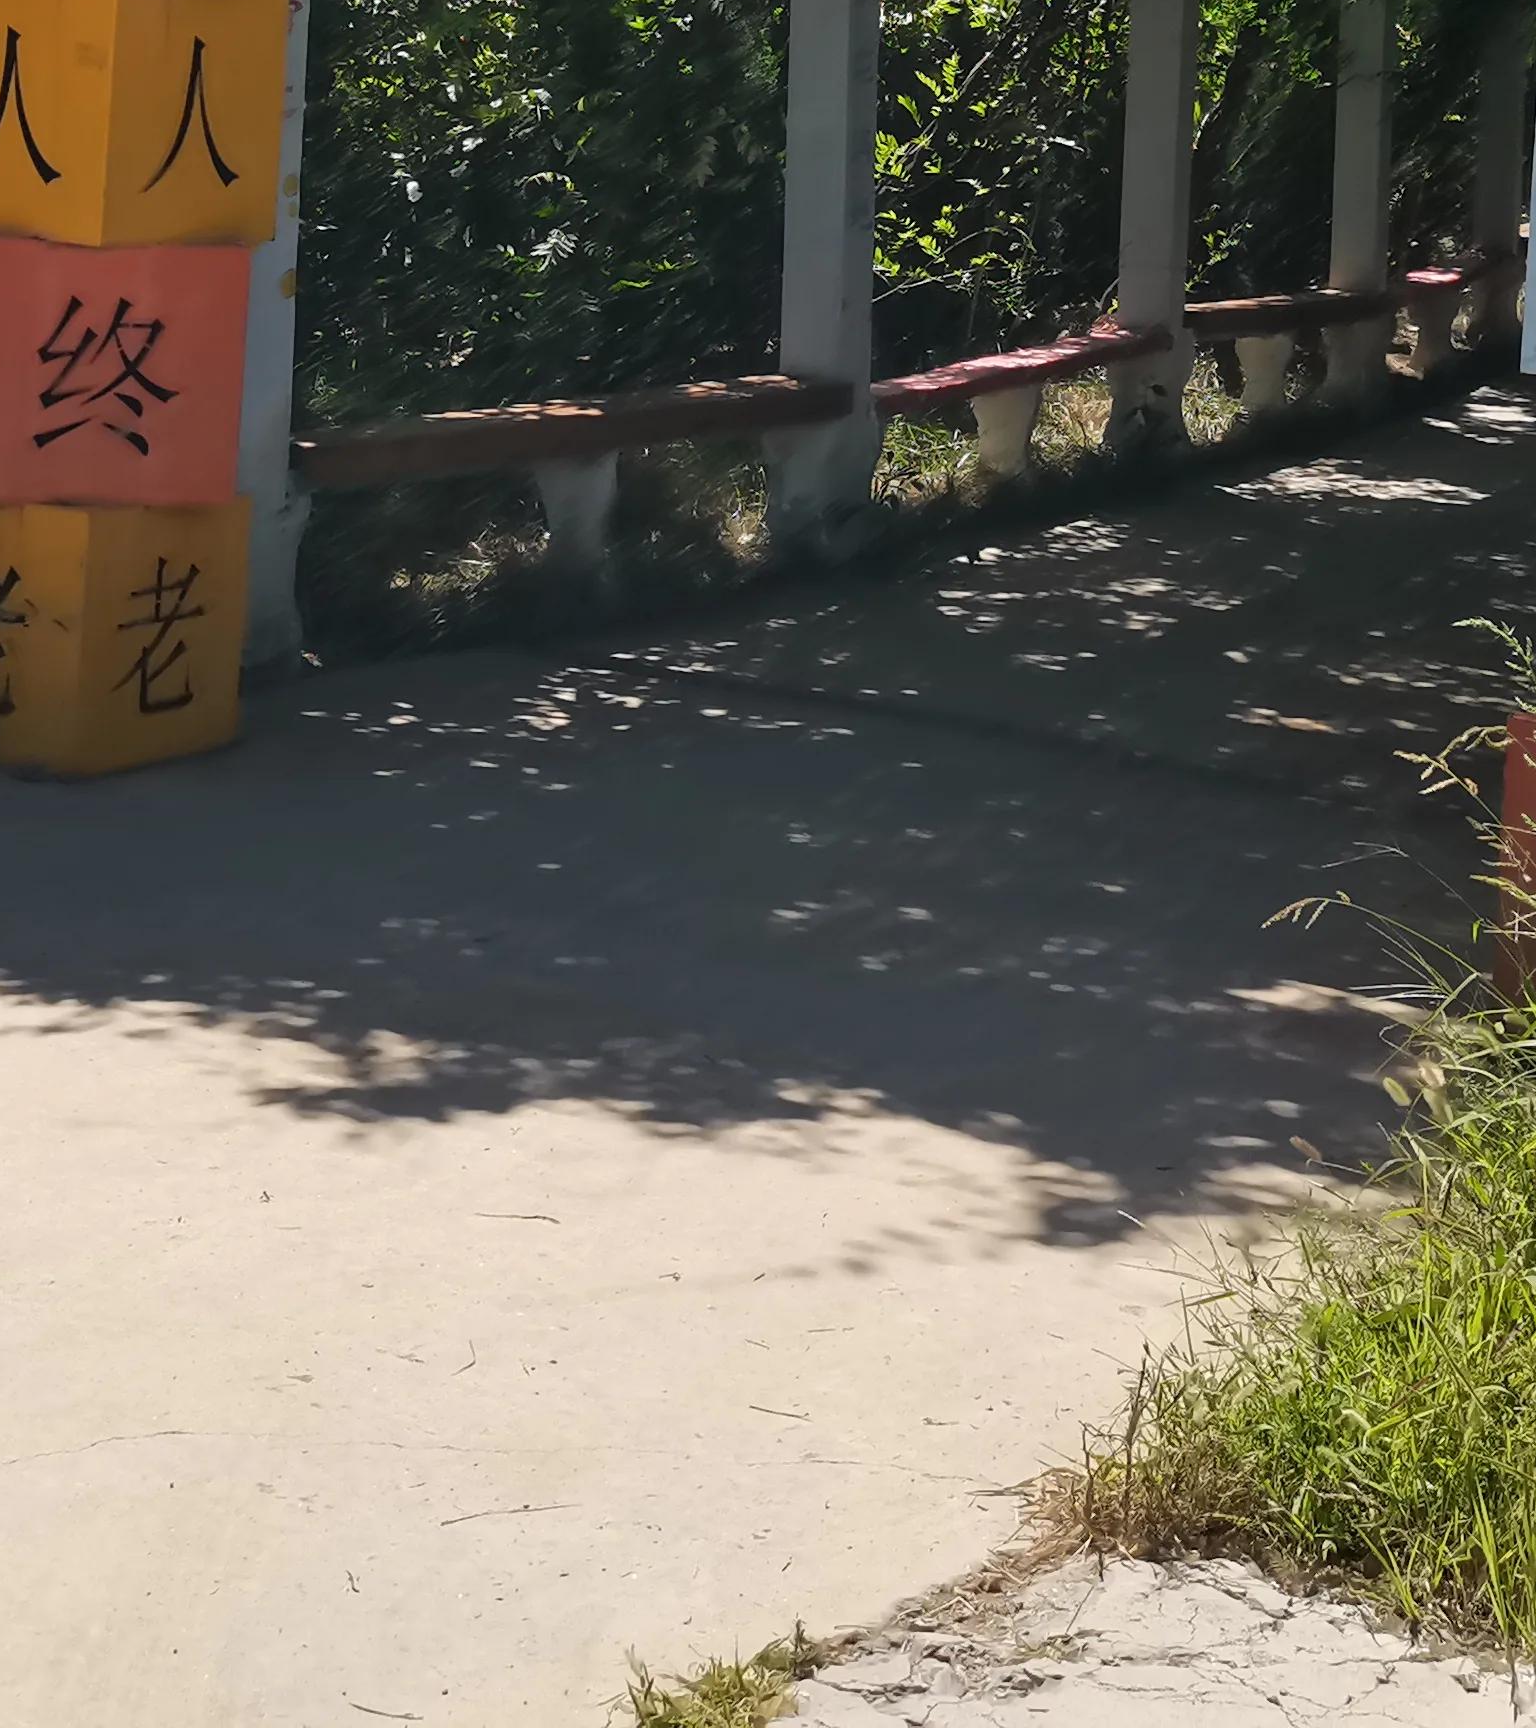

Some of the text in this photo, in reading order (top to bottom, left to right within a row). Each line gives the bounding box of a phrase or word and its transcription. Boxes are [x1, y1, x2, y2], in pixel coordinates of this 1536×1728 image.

[141, 35, 240, 194] 人
[32, 295, 180, 457] 终
[112, 556, 206, 714] 老
